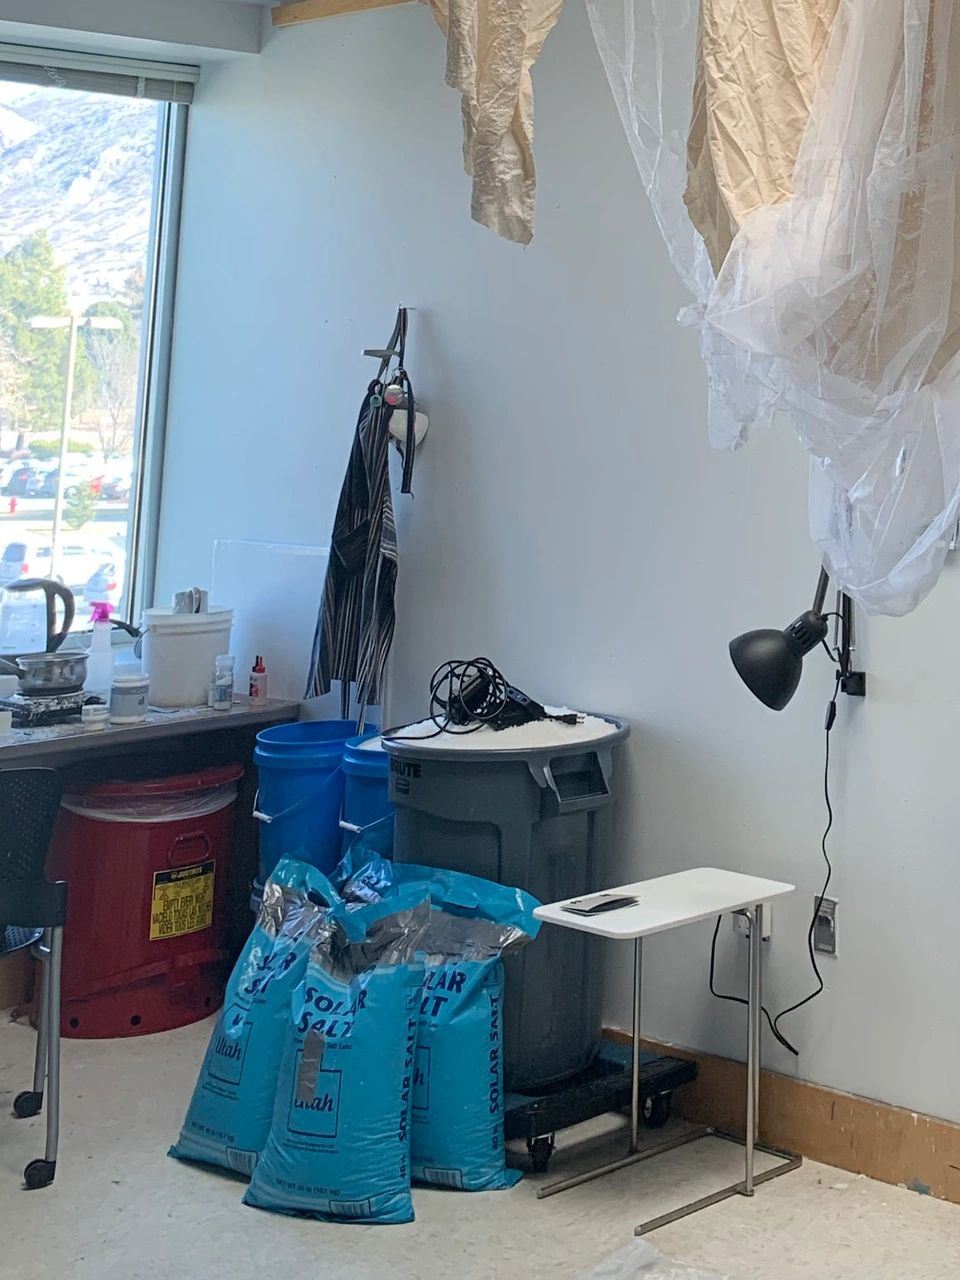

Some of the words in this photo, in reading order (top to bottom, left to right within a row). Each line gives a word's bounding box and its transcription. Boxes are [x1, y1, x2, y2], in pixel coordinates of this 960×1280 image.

[423, 970, 467, 993] LAR
[304, 987, 368, 1017] SOLAR
[420, 995, 449, 1017] LT
[297, 1011, 356, 1038] SALT
[489, 994, 499, 1041] SALT
[215, 1036, 241, 1061] Utah
[404, 1018, 416, 1068] SALT
[489, 1048, 499, 1114] SOLAR
[399, 1076, 411, 1142] SOLAR
